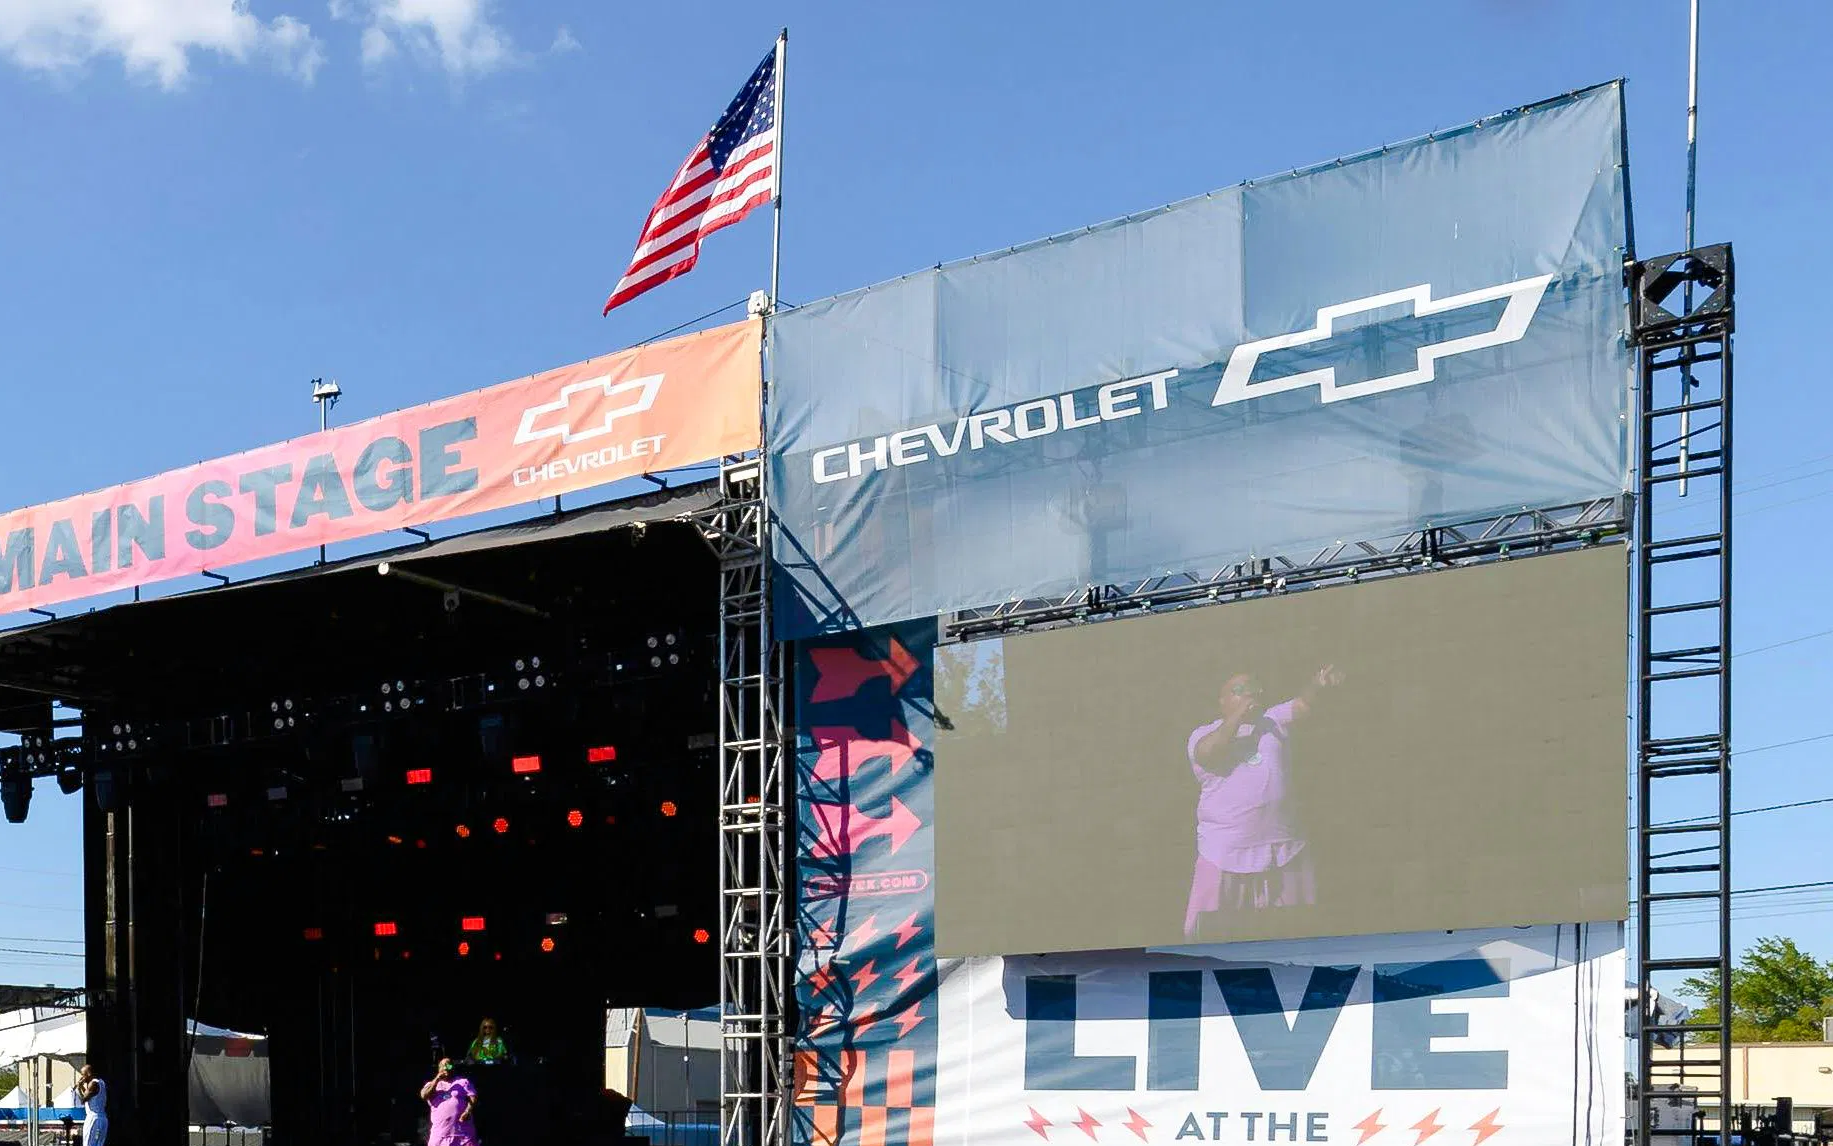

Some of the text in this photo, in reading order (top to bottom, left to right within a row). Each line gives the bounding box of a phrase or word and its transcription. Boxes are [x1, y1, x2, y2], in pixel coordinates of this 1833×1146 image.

[184, 416, 479, 552] STAGE
[513, 433, 666, 487] CHEVROLET
[812, 369, 1178, 484] CHEVROLET
[1024, 957, 1509, 1091] LIVE
[1175, 1112, 1329, 1142] AT THE
